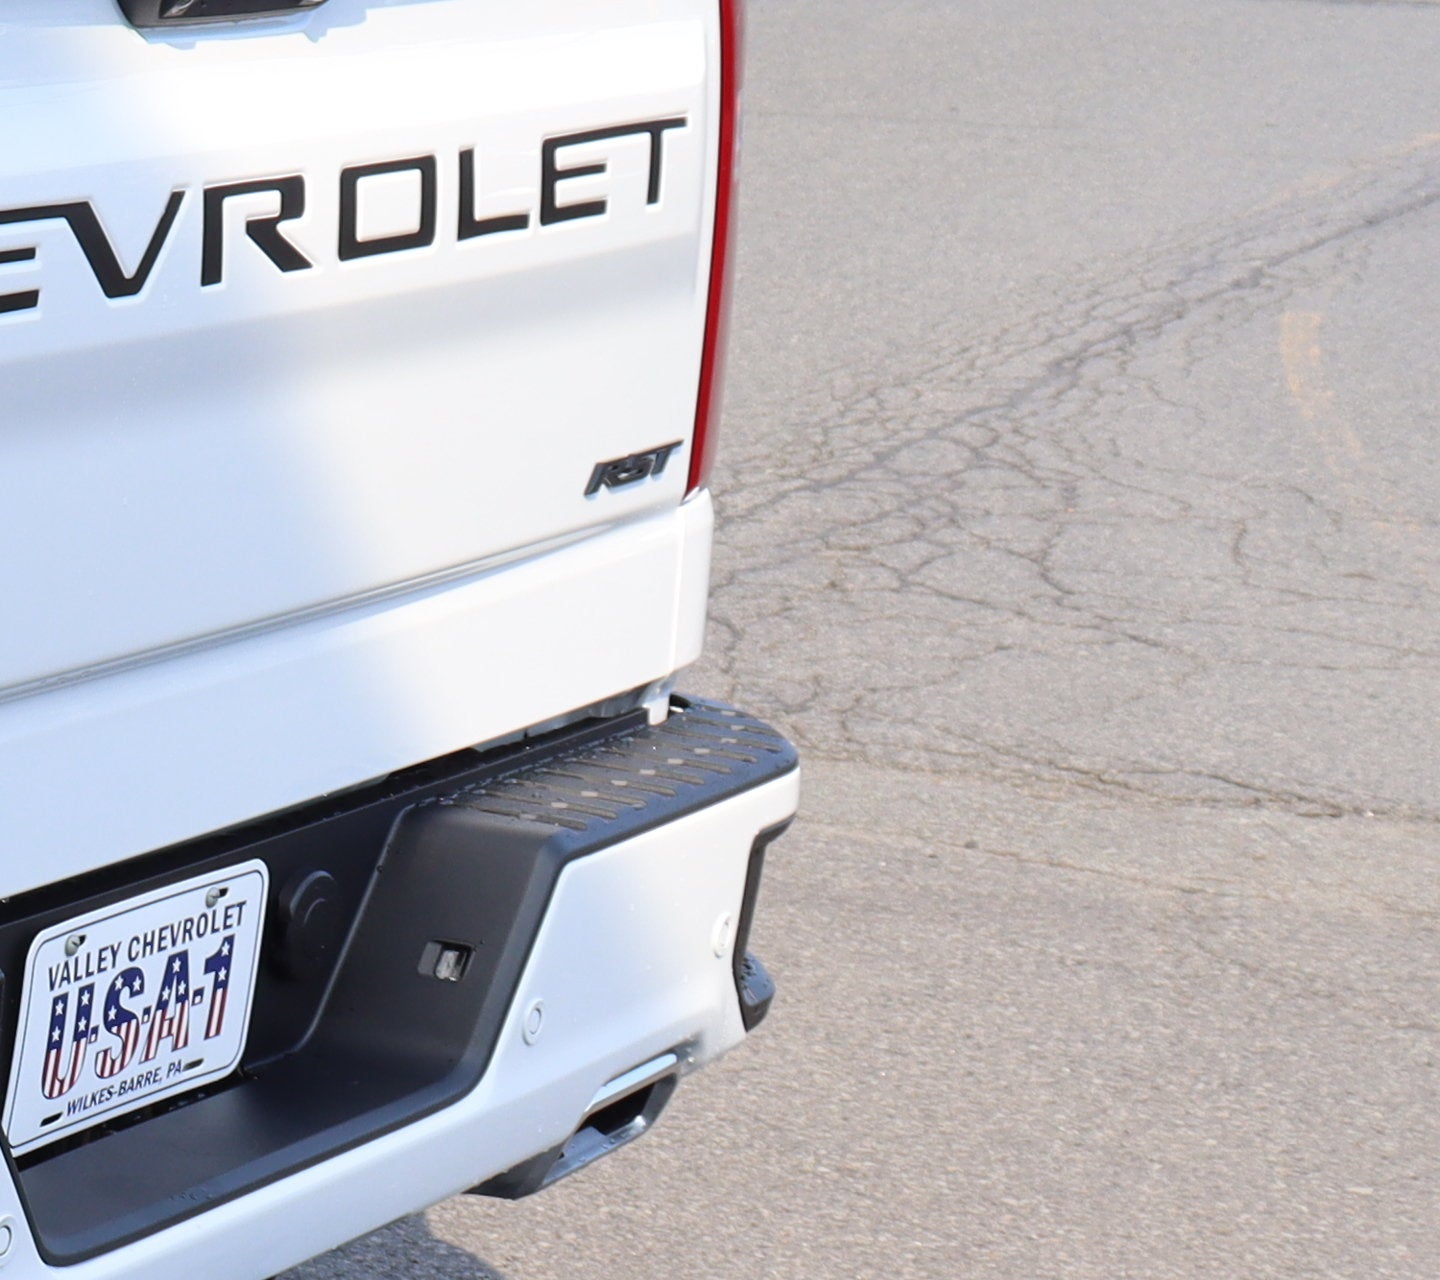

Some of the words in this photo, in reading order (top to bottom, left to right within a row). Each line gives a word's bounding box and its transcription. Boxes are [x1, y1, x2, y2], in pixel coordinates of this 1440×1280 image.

[47, 948, 123, 991] VALLEY
[127, 900, 247, 963] CHEVROLET
[66, 1068, 163, 1116] WILKES-BARRE,
[166, 1058, 184, 1079] PA
